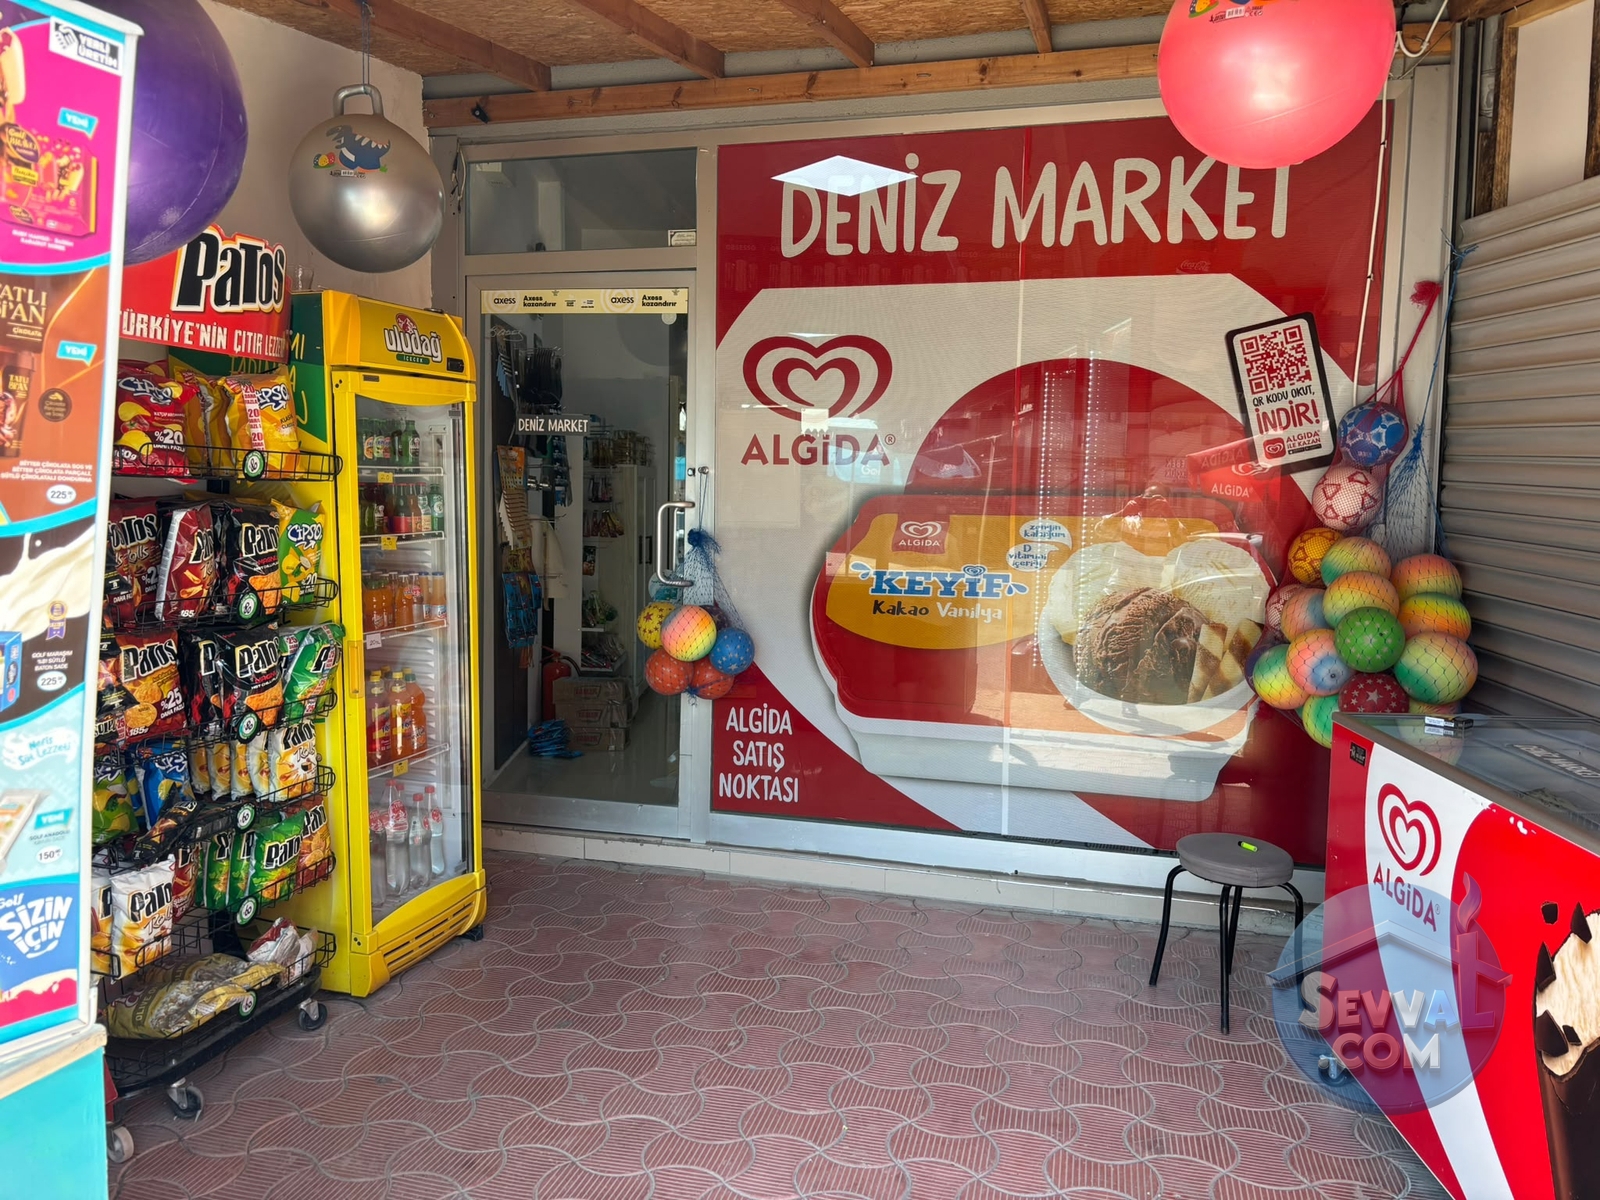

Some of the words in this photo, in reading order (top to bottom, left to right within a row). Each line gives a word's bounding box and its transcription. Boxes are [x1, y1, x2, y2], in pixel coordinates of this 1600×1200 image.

[780, 153, 963, 258] DENİZ
[992, 155, 1304, 249] MARKET
[0, 283, 47, 307] ATLI
[494, 297, 517, 306] axess
[611, 296, 635, 305] axess
[642, 294, 663, 302] Axess
[120, 309, 228, 351] ÜRKİYE'NİN
[383, 325, 443, 363] uludağ
[1252, 396, 1264, 407] QR
[1267, 391, 1289, 405] KODU
[518, 415, 545, 433] DENİZ
[548, 419, 589, 434] MARKET
[1255, 399, 1321, 435] İNDİR!
[1298, 437, 1321, 447] KAZAN
[1023, 544, 1032, 552] D
[873, 600, 929, 616] Kakao
[936, 602, 1002, 623] Vanilya
[726, 703, 793, 735] ALGİDA
[732, 740, 785, 773] SATIŞ
[719, 772, 799, 803] NOKTASI
[13, 919, 66, 956] İÇİN
